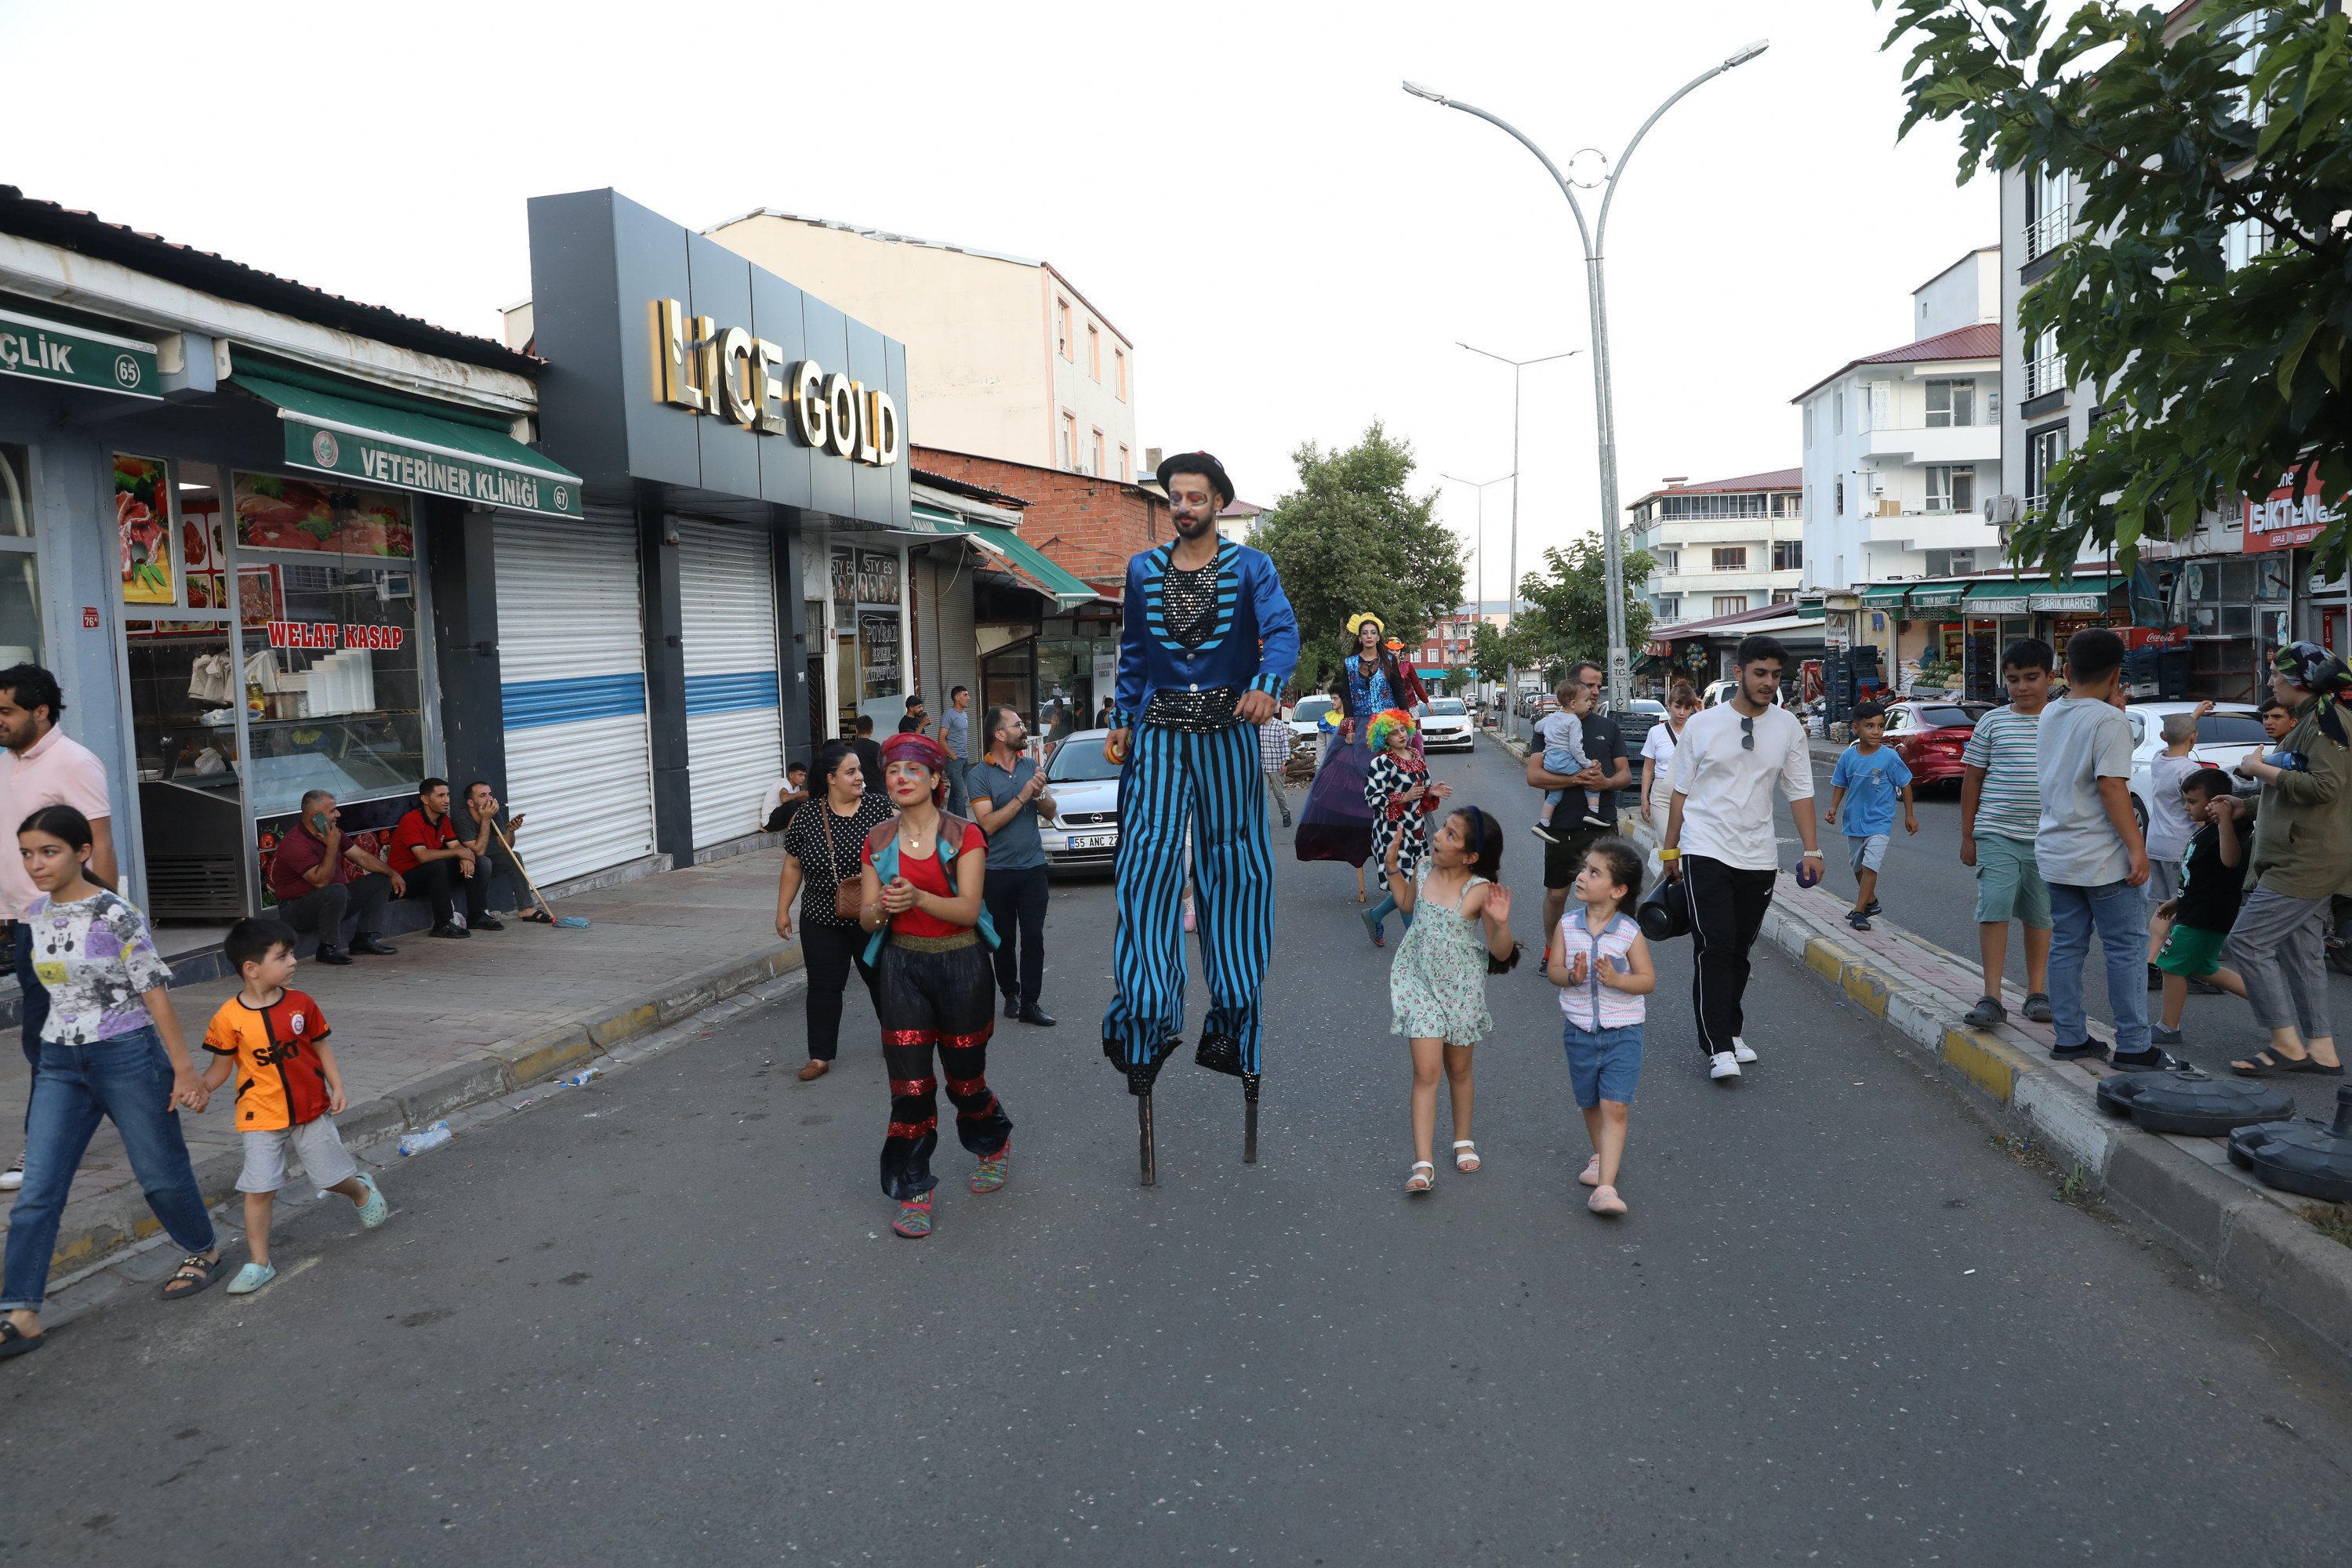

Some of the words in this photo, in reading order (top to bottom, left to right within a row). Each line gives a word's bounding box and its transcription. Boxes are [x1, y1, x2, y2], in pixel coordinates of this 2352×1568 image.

[119, 361, 136, 382] 65
[793, 360, 899, 467] GOLD
[361, 447, 471, 496] VETERİNER
[475, 471, 539, 508] KLİNİĞİ
[556, 492, 566, 505] 67
[1934, 595, 1951, 604] MARKET
[1972, 601, 1989, 612] TARIK
[1991, 600, 2016, 612] MARKET
[2063, 597, 2094, 609] MARKET
[267, 621, 338, 649] WELAT
[343, 624, 403, 650] KASAP
[1075, 837, 1085, 848] 55
[1089, 837, 1105, 847] ANC
